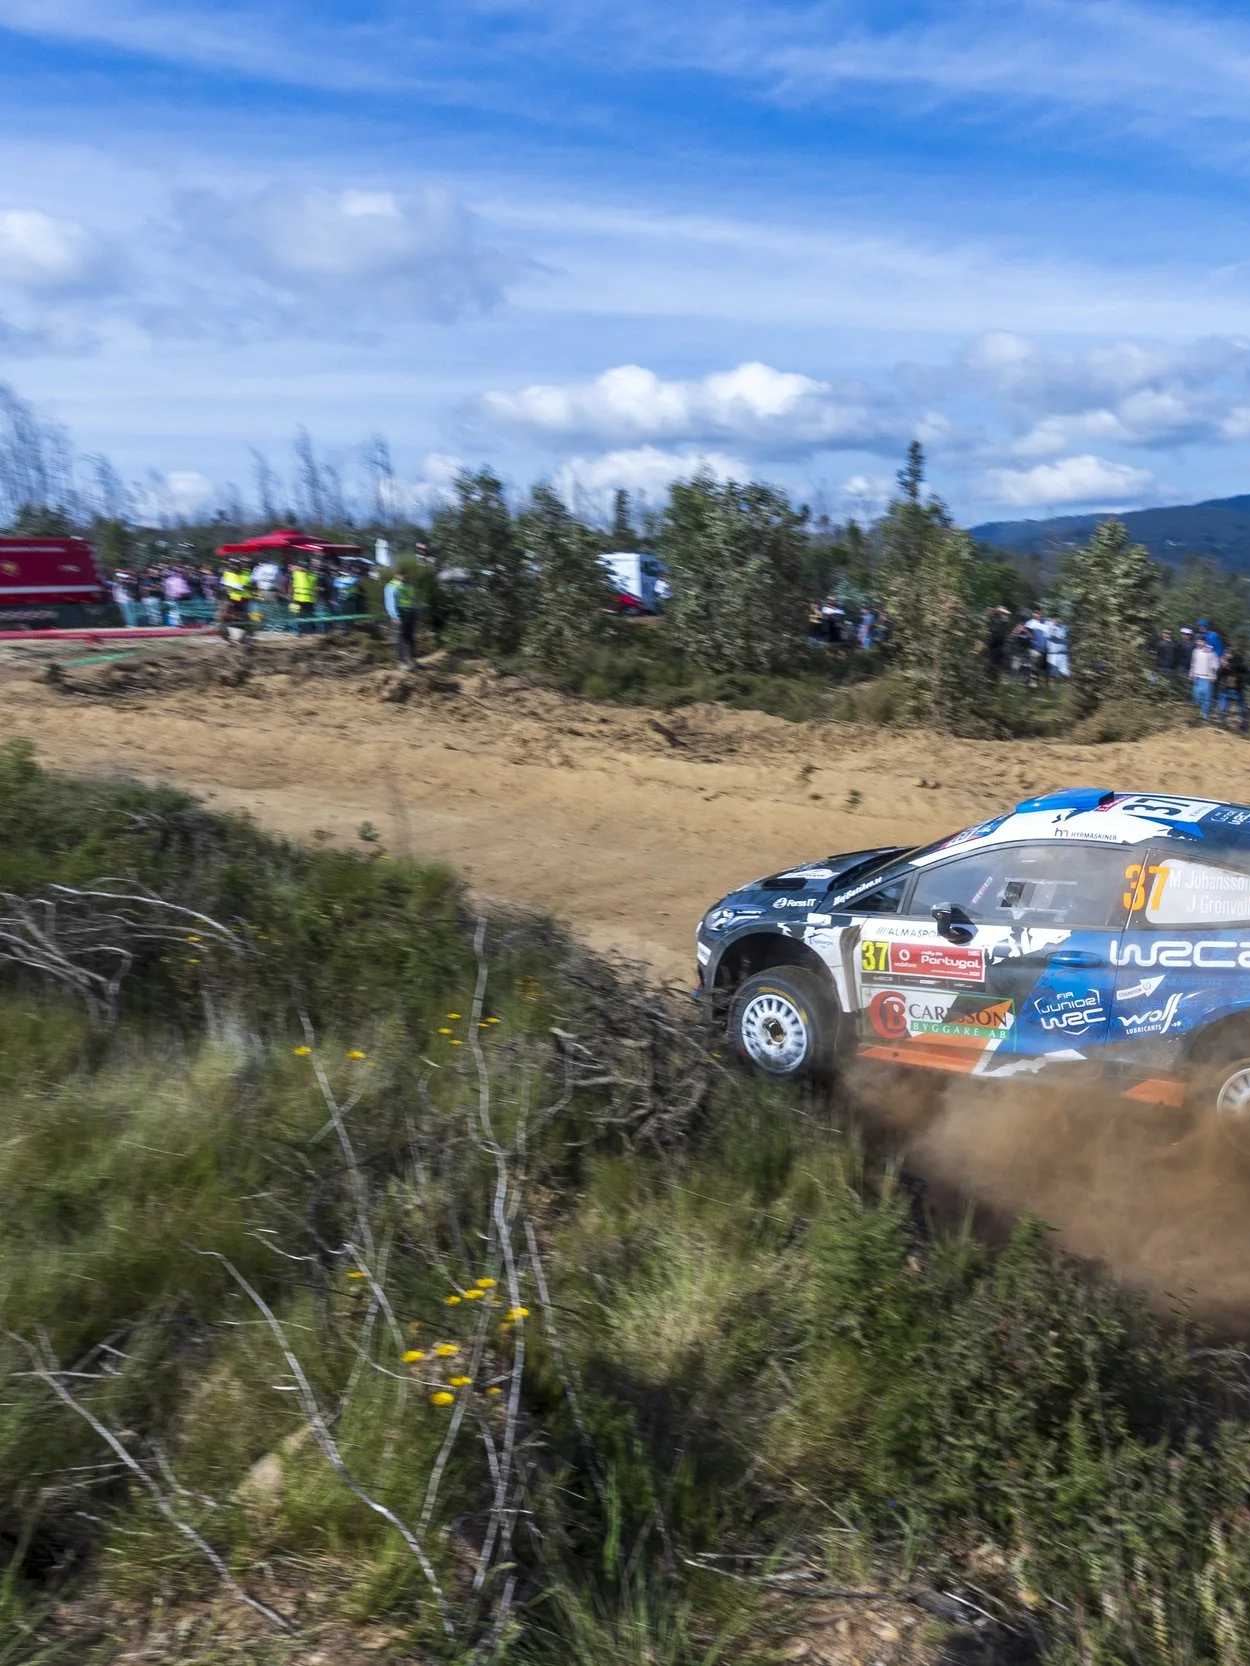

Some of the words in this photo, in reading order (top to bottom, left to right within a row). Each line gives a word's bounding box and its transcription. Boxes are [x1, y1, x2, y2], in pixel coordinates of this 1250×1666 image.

[1122, 797, 1190, 816] 37
[1070, 831, 1118, 841] HYRMASKINER
[1123, 863, 1170, 912] 37
[1169, 870, 1182, 888] M
[786, 899, 807, 907] Forss
[807, 898, 817, 907] IT
[1187, 897, 1196, 913] J
[861, 940, 888, 971] 37
[920, 956, 981, 969] Portugal
[1057, 991, 1074, 1000] FIA
[1041, 997, 1097, 1014] JUNIOR
[1117, 992, 1184, 1034] wolf
[1040, 1008, 1106, 1030] WRC
[911, 1022, 979, 1037] BYGGARE
[988, 1031, 1007, 1040] AB
[1125, 1023, 1162, 1035] LUBRICANTS
